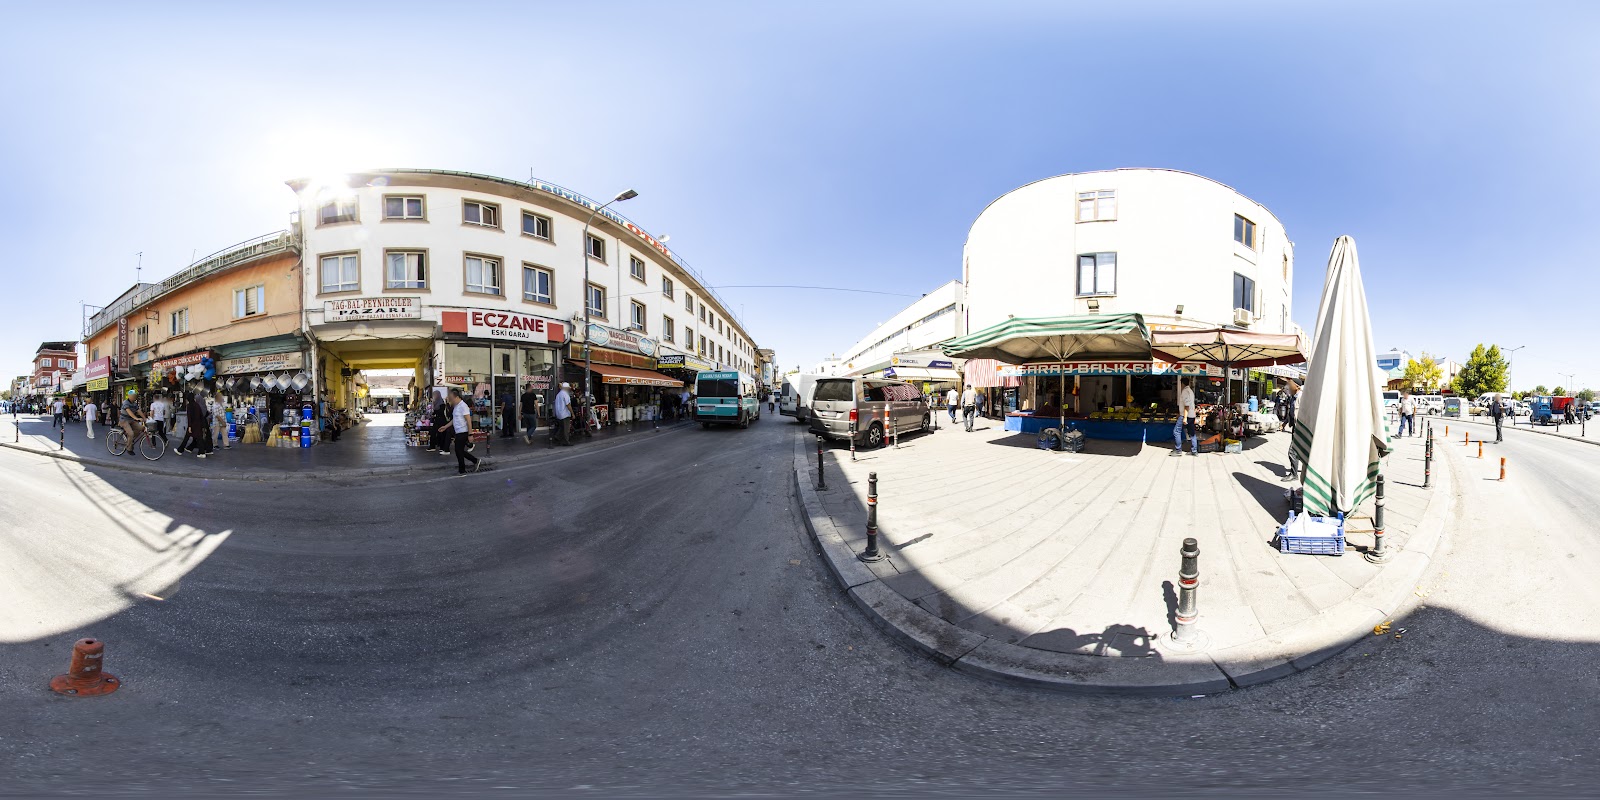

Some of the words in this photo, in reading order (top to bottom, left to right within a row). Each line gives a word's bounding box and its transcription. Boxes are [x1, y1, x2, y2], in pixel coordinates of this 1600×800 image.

[627, 223, 668, 254] OTEL
[340, 308, 406, 316] PAZARI
[472, 311, 544, 332] ECZANE
[1018, 363, 1072, 374] SARAY
